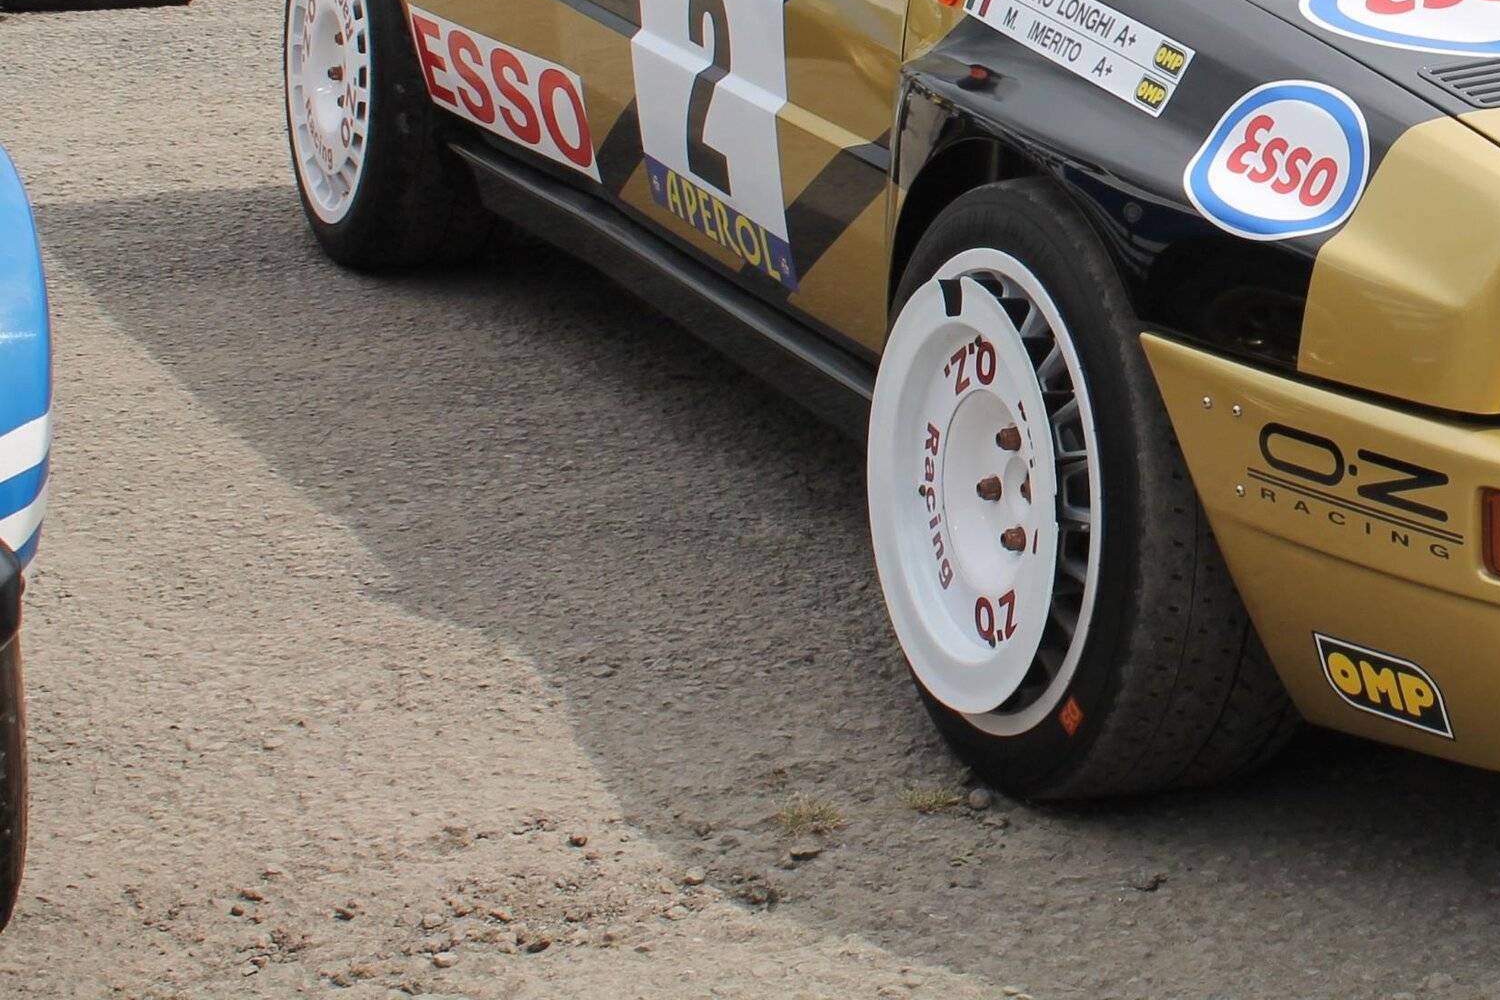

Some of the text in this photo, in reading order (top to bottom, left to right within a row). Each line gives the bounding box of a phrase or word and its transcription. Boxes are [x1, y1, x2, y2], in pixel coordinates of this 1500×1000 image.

[1002, 6, 1114, 78] M. IMERITO A+
[1114, 25, 1138, 49] A+
[1154, 43, 1185, 71] OMP
[411, 10, 594, 169] ESSO
[1137, 81, 1167, 110] OMP
[666, 170, 782, 282] APEROL
[926, 421, 954, 591] Racing
[1259, 487, 1450, 561] RACING
[1327, 651, 1435, 717] OMP
